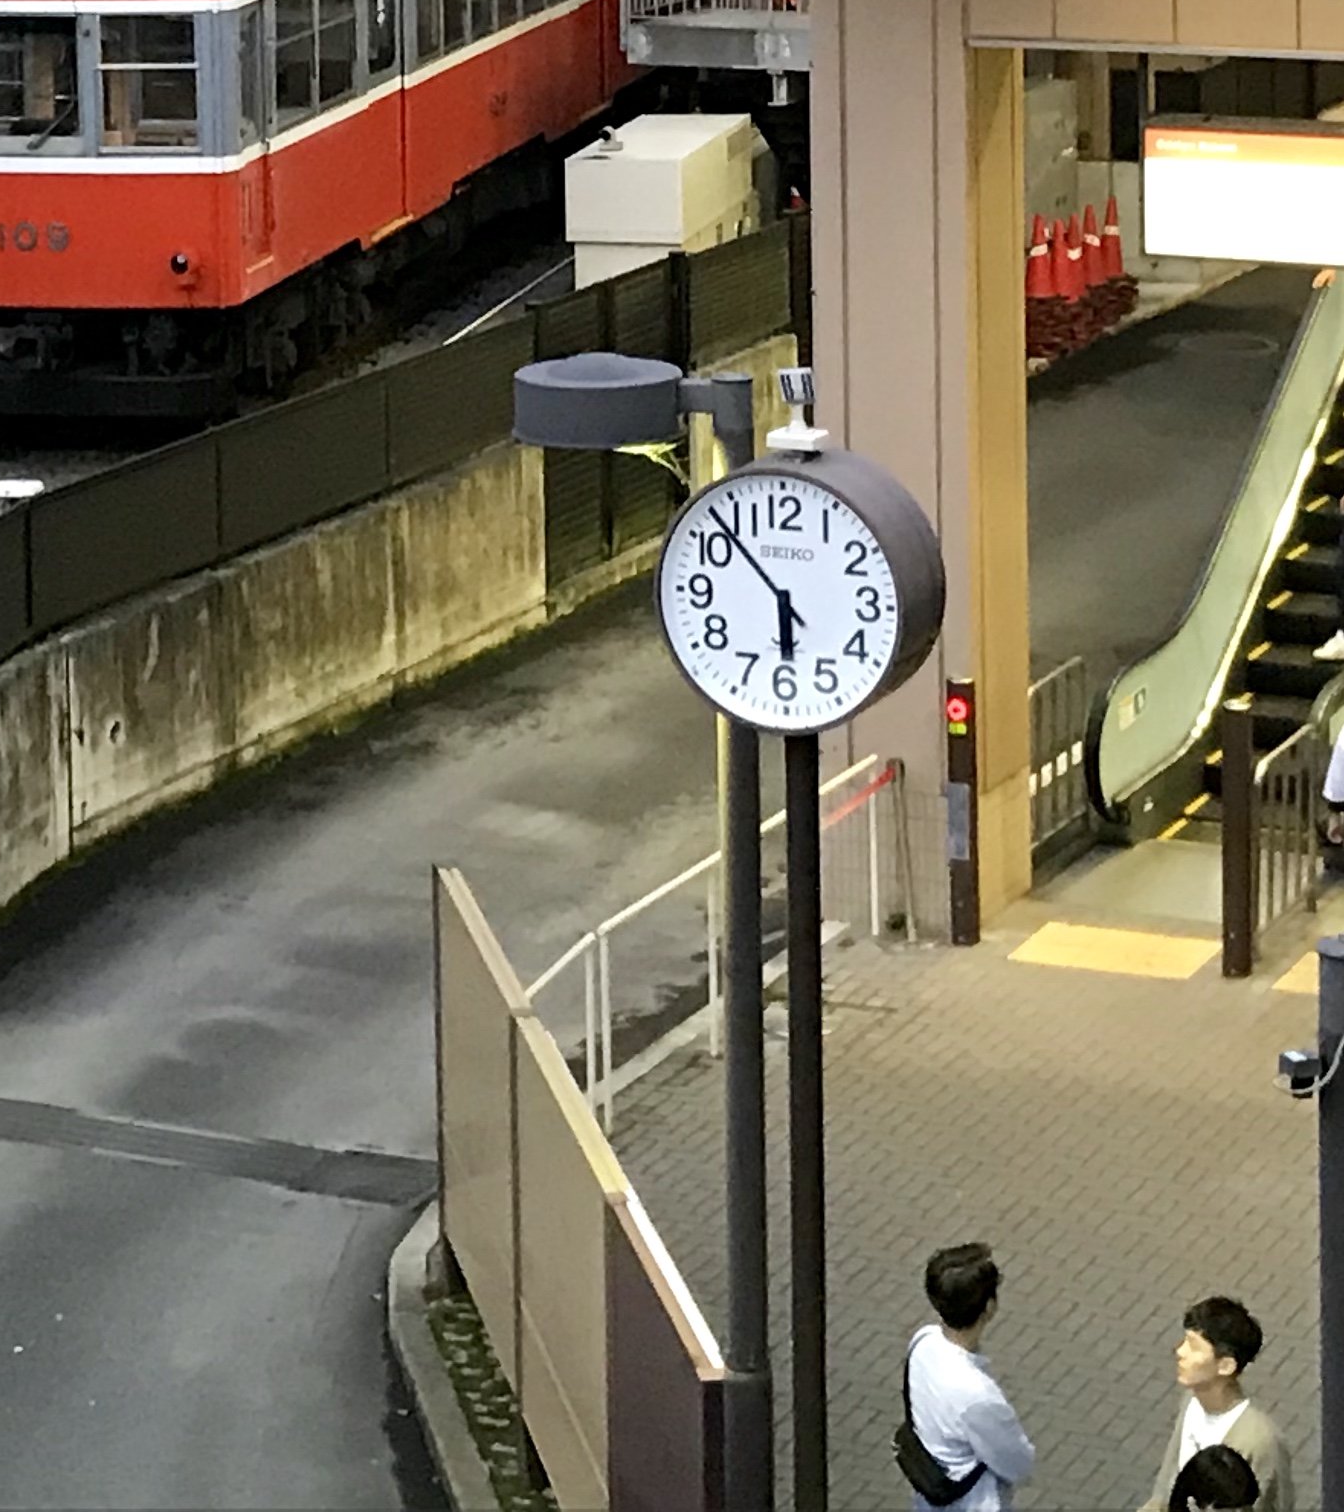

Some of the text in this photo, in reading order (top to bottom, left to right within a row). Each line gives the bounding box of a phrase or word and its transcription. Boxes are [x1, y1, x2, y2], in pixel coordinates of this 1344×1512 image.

[734, 501, 758, 537] 11
[768, 494, 803, 532] 12
[822, 508, 830, 544] 1
[699, 531, 733, 568] 10
[760, 544, 815, 562] SEIKO
[843, 540, 869, 577] 2
[688, 573, 713, 610] 9
[855, 586, 881, 623] 3
[703, 614, 729, 651] 8
[842, 629, 870, 665] 4
[735, 651, 760, 687] 7
[772, 664, 798, 702] 6
[812, 657, 839, 695] 5
